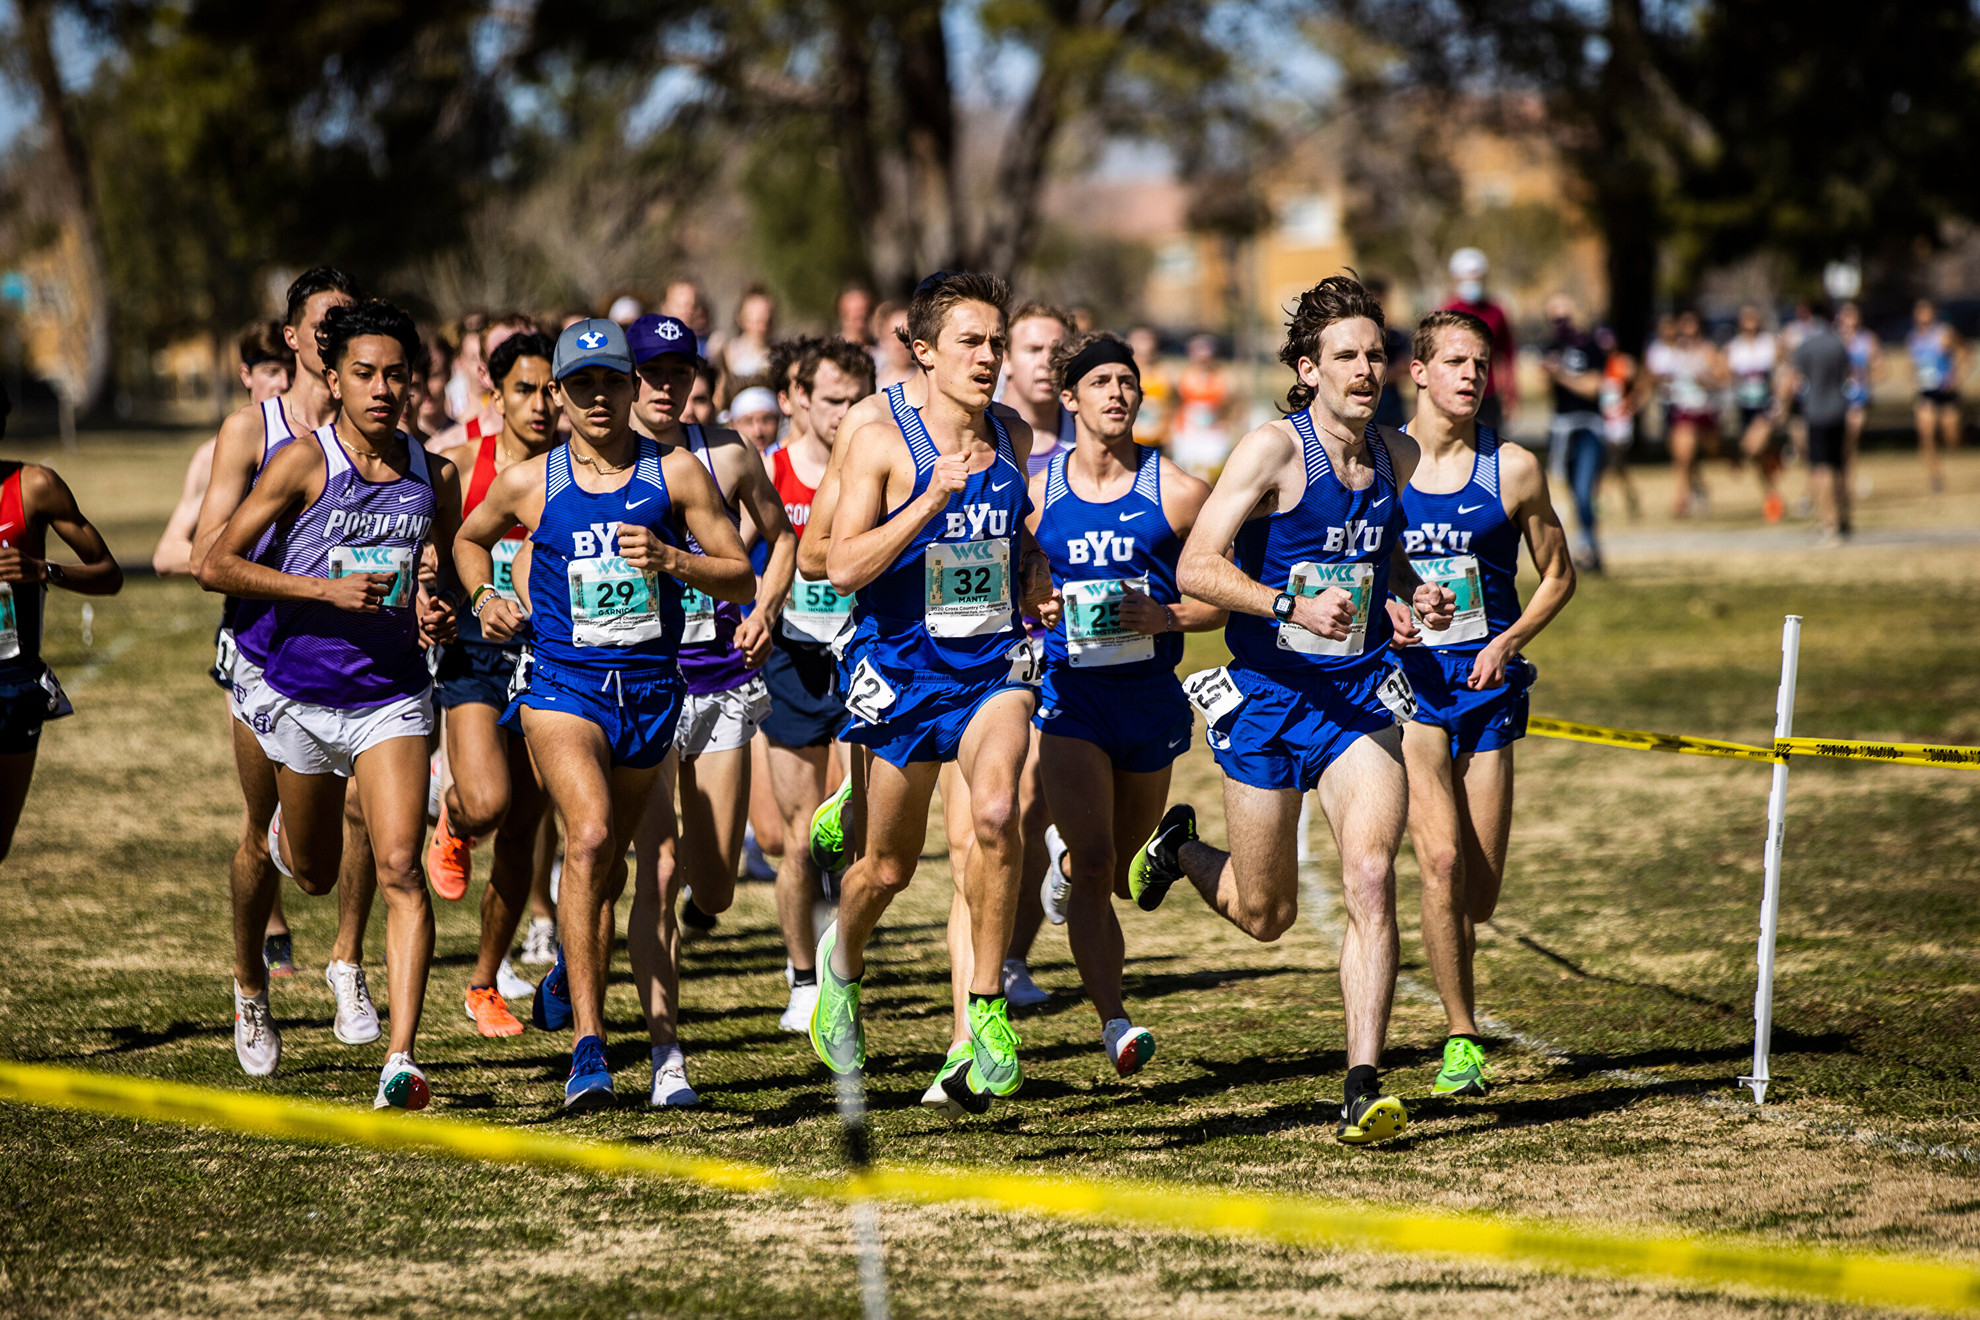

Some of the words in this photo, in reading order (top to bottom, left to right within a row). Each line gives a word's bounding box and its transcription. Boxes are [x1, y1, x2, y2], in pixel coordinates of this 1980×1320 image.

[579, 331, 604, 349] Y
[322, 509, 432, 541] PORTLAND
[944, 503, 1008, 540] BYU
[572, 521, 624, 558] BY
[1067, 530, 1135, 566] BYU
[1323, 519, 1384, 556] BYU
[1404, 523, 1472, 554] BYU
[350, 547, 394, 565] WCC
[949, 541, 994, 560] WCC
[1315, 564, 1357, 582] WCC
[1411, 559, 1456, 576] WCC
[953, 567, 991, 595] 32
[597, 581, 634, 608] 29
[806, 585, 837, 606] 55
[958, 595, 988, 603] MANTZ
[597, 607, 636, 616] GARNICA
[1085, 628, 1133, 636] ARMSTRON
[1019, 643, 1041, 682] 3
